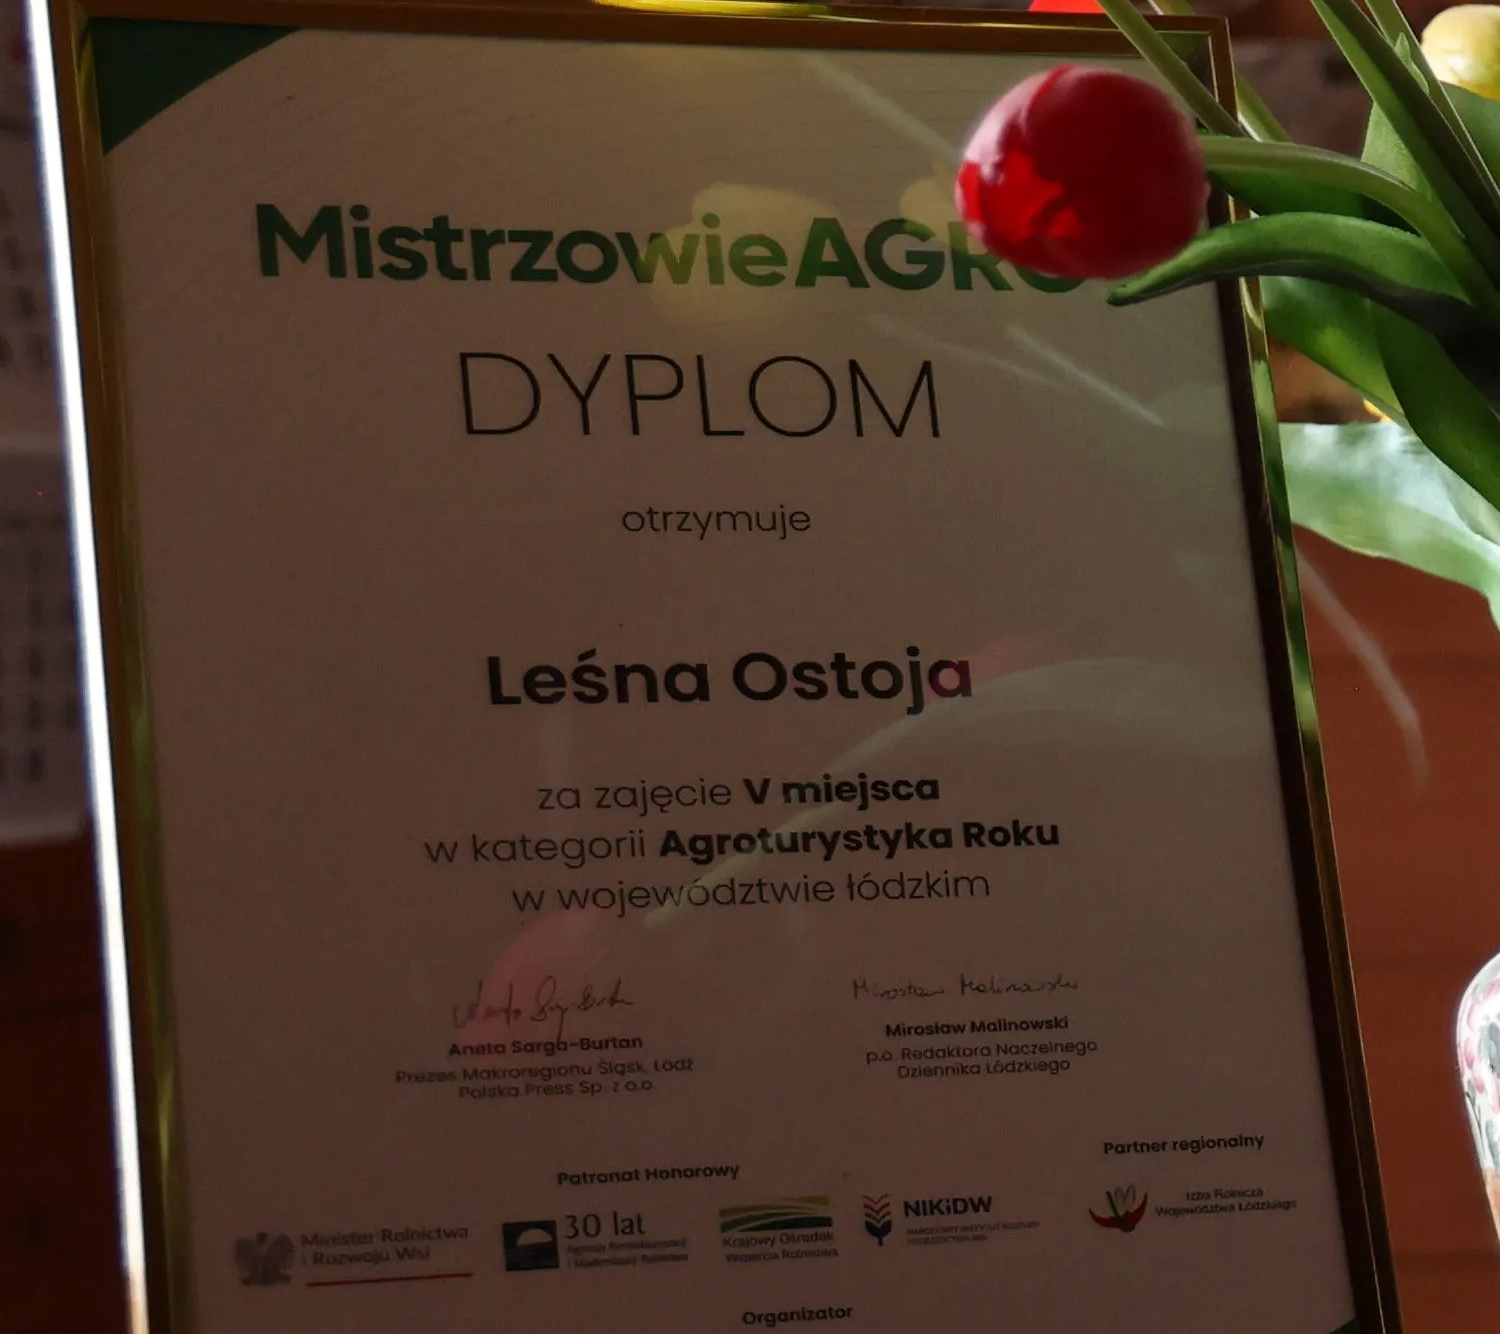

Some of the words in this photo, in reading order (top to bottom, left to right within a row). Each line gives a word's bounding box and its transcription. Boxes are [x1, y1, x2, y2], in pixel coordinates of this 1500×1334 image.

[256, 204, 1086, 294] MistrzowieAGR
[459, 352, 940, 439] DYPLOM
[622, 503, 811, 540] otrzymuje
[486, 648, 710, 705] Leśna
[732, 646, 972, 715] Ostoja
[539, 784, 581, 811] za
[595, 778, 731, 816] zajęcie
[742, 778, 771, 805] V
[782, 771, 940, 809] miejsca
[425, 839, 458, 863] w
[472, 831, 645, 868] kategorii
[659, 823, 952, 866] Agroturystyka
[964, 820, 1059, 849] Roku
[514, 887, 544, 911] w
[558, 875, 835, 918] województwie
[847, 870, 990, 906] łódzkim
[886, 1022, 964, 1037] Mirosław
[970, 1016, 1068, 1033] Malinowski
[1104, 1141, 1167, 1154] Partner
[1173, 1135, 1264, 1153] regionalny
[566, 1214, 600, 1238] 30
[613, 1211, 645, 1235] lat
[904, 1196, 992, 1217] NIKiDW
[743, 1307, 853, 1327] Organizator
